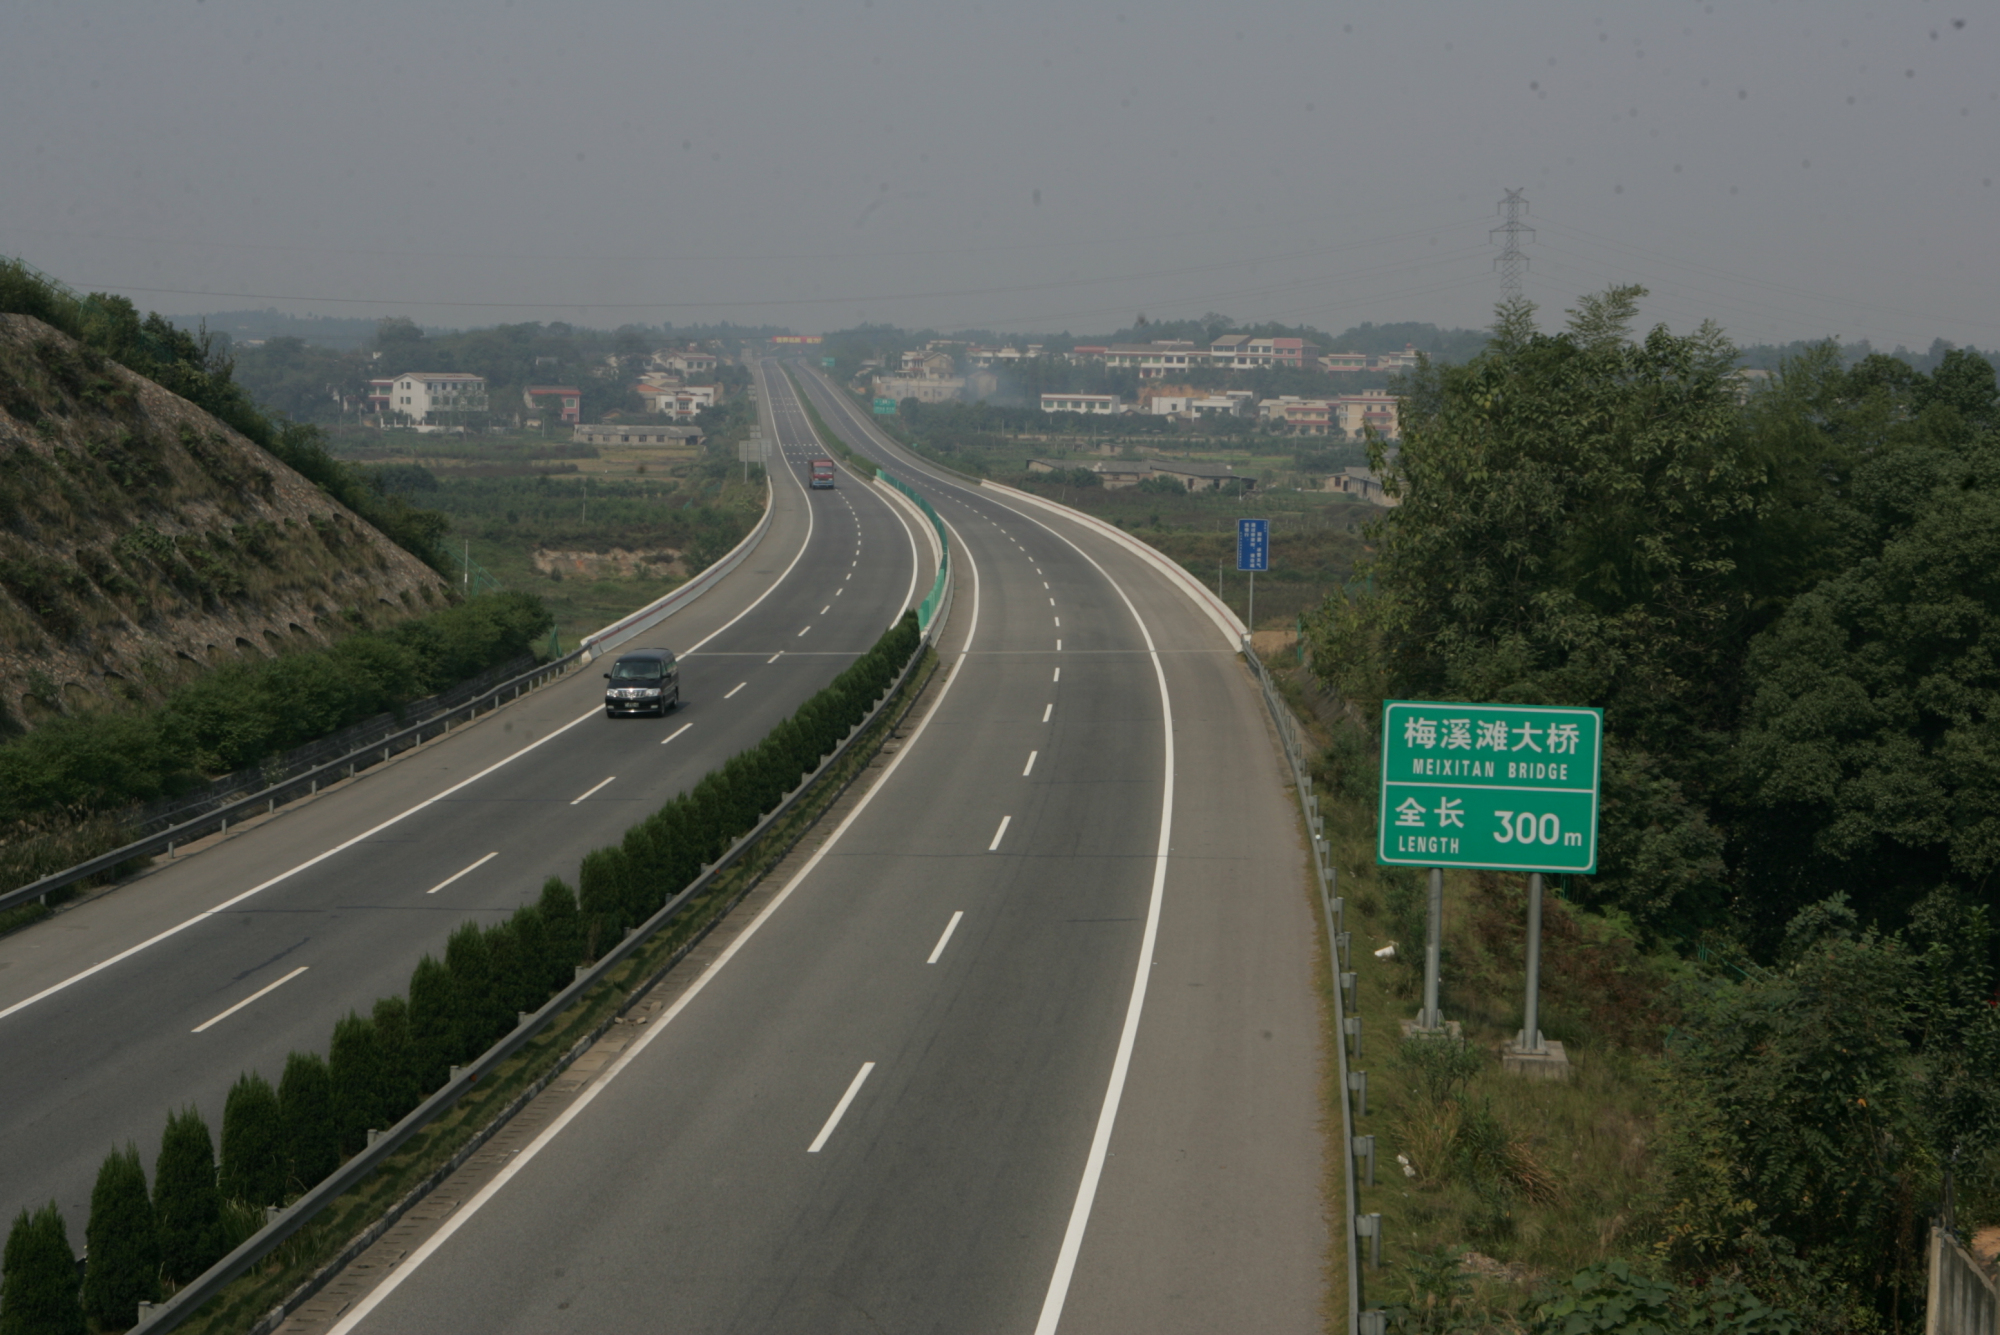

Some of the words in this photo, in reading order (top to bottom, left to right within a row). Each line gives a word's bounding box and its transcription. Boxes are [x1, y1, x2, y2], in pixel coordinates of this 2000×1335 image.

[1403, 716, 1580, 755] 梅溪滩大桥
[1412, 758, 1495, 778] MEIXITAN
[1508, 762, 1568, 780] BRIDGE
[1395, 796, 1465, 829] 全长
[1398, 835, 1460, 854] LENGTH
